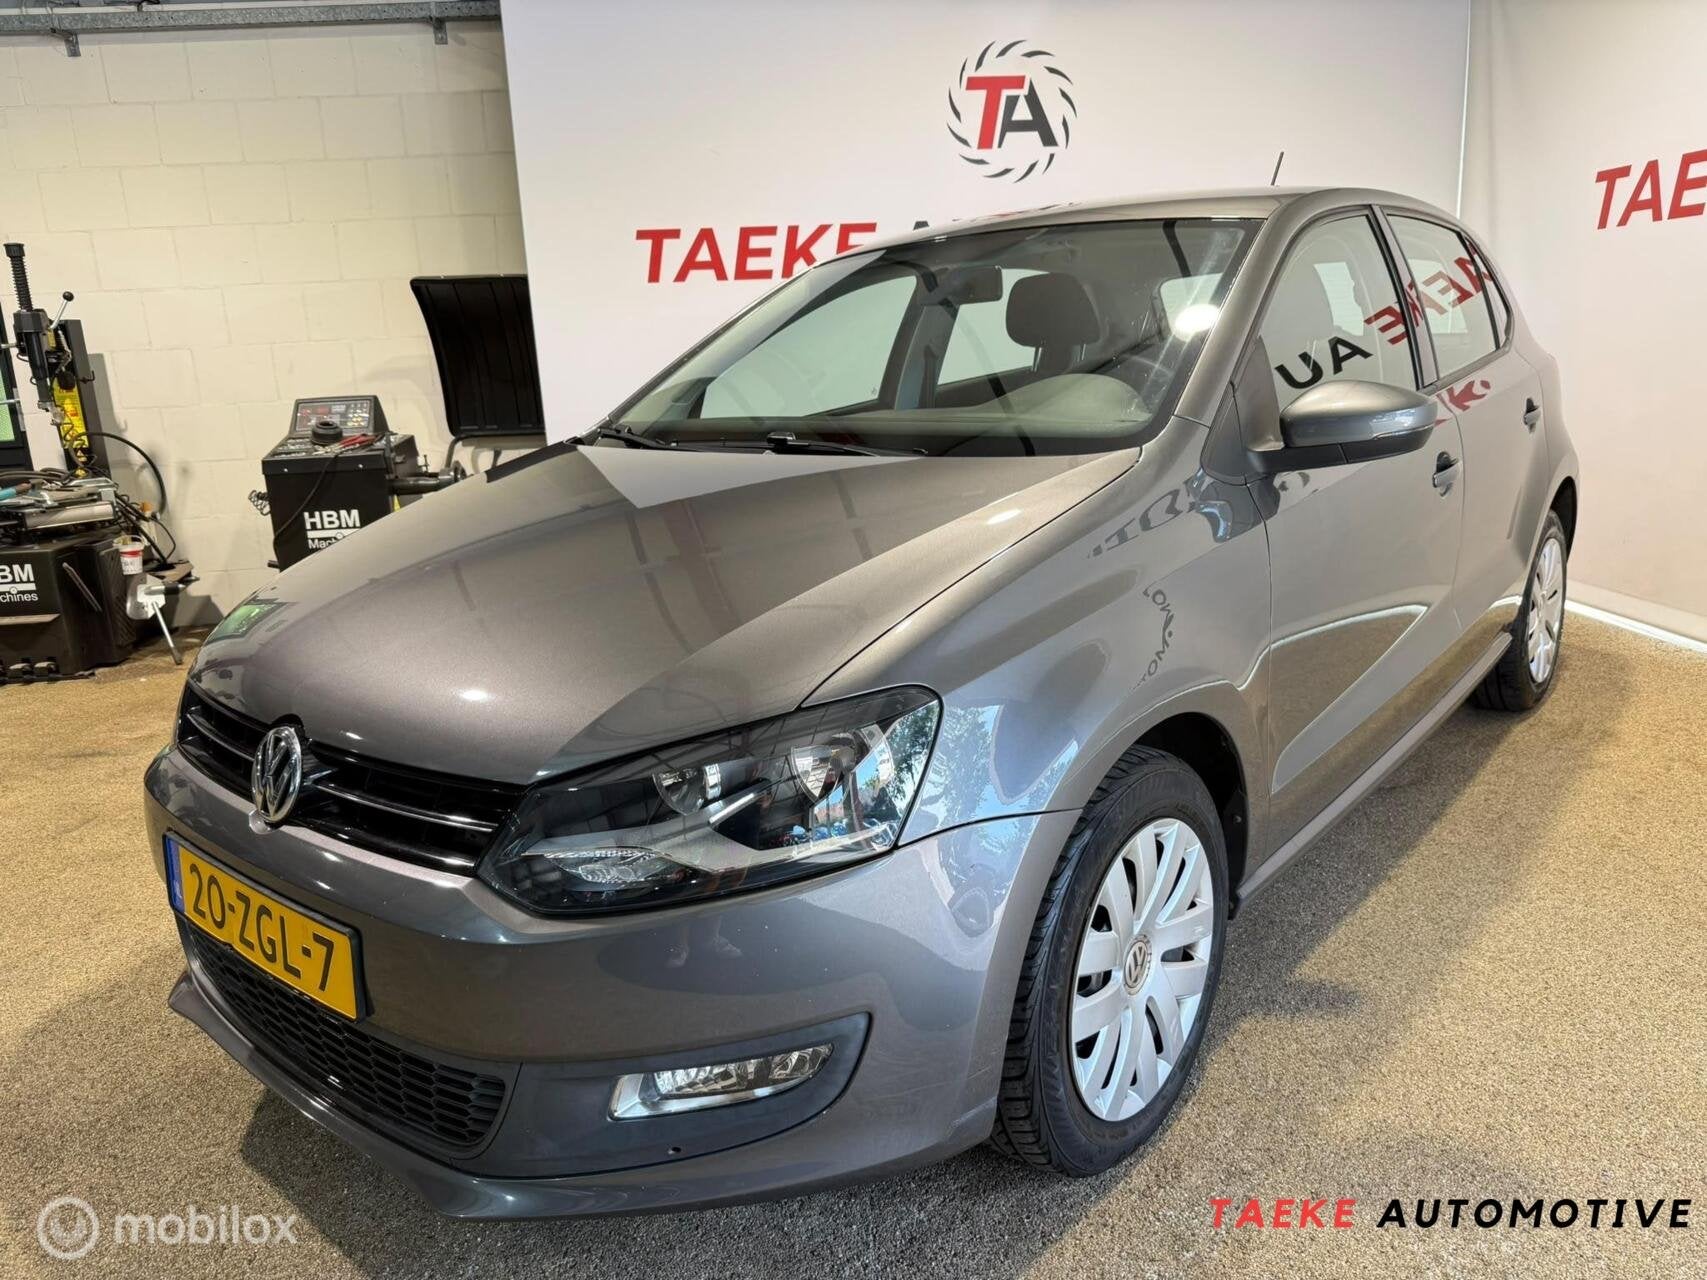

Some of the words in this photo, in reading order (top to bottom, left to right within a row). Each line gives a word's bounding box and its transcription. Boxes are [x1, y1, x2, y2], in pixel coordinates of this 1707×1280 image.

[965, 75, 1059, 150] TA
[303, 509, 361, 530] HBM
[189, 863, 335, 992] 20-ZGL-7
